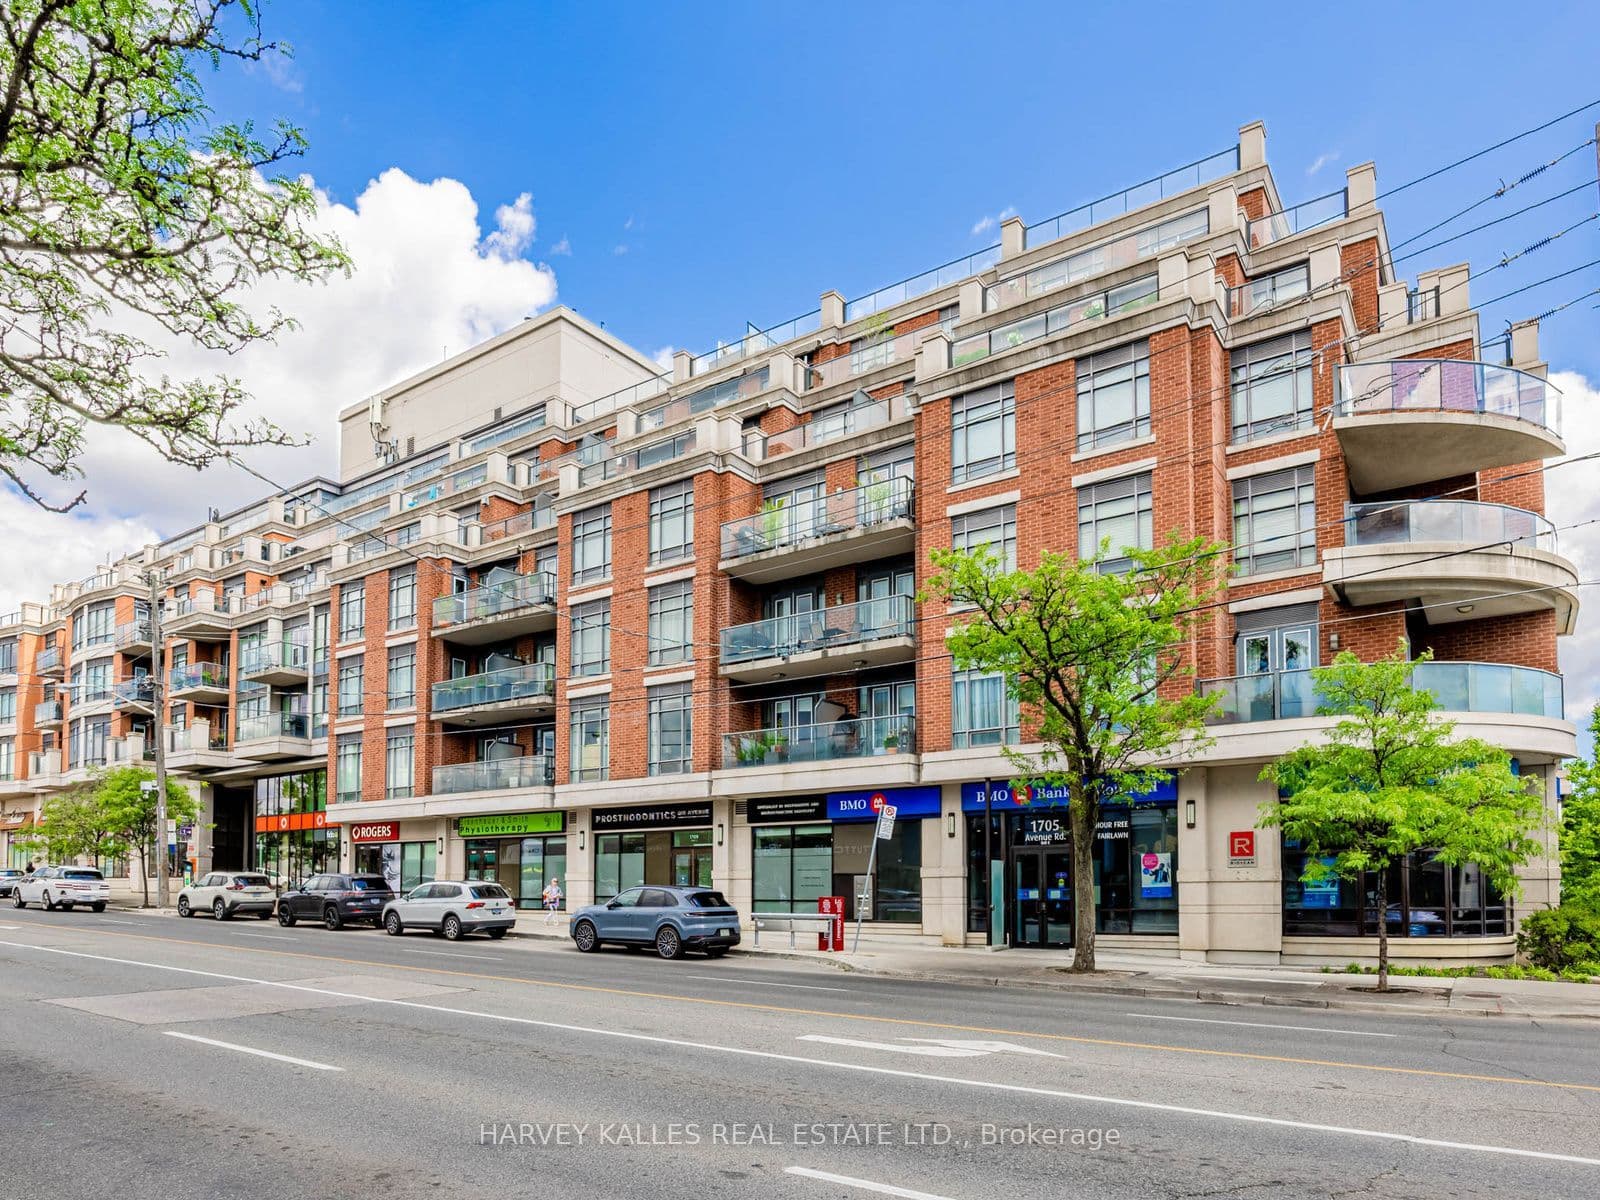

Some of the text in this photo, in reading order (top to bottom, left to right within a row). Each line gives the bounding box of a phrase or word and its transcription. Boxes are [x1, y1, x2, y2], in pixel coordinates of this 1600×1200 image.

[840, 799, 866, 811] BMO
[595, 811, 676, 823] PROSTHODONTICS
[1030, 819, 1060, 833] 1705
[1113, 820, 1128, 828] FREE
[361, 825, 392, 838] ROGERS
[1024, 831, 1067, 842] Avenue Rd.
[1097, 831, 1129, 840] FAIRLAWN
[1234, 838, 1250, 854] R
